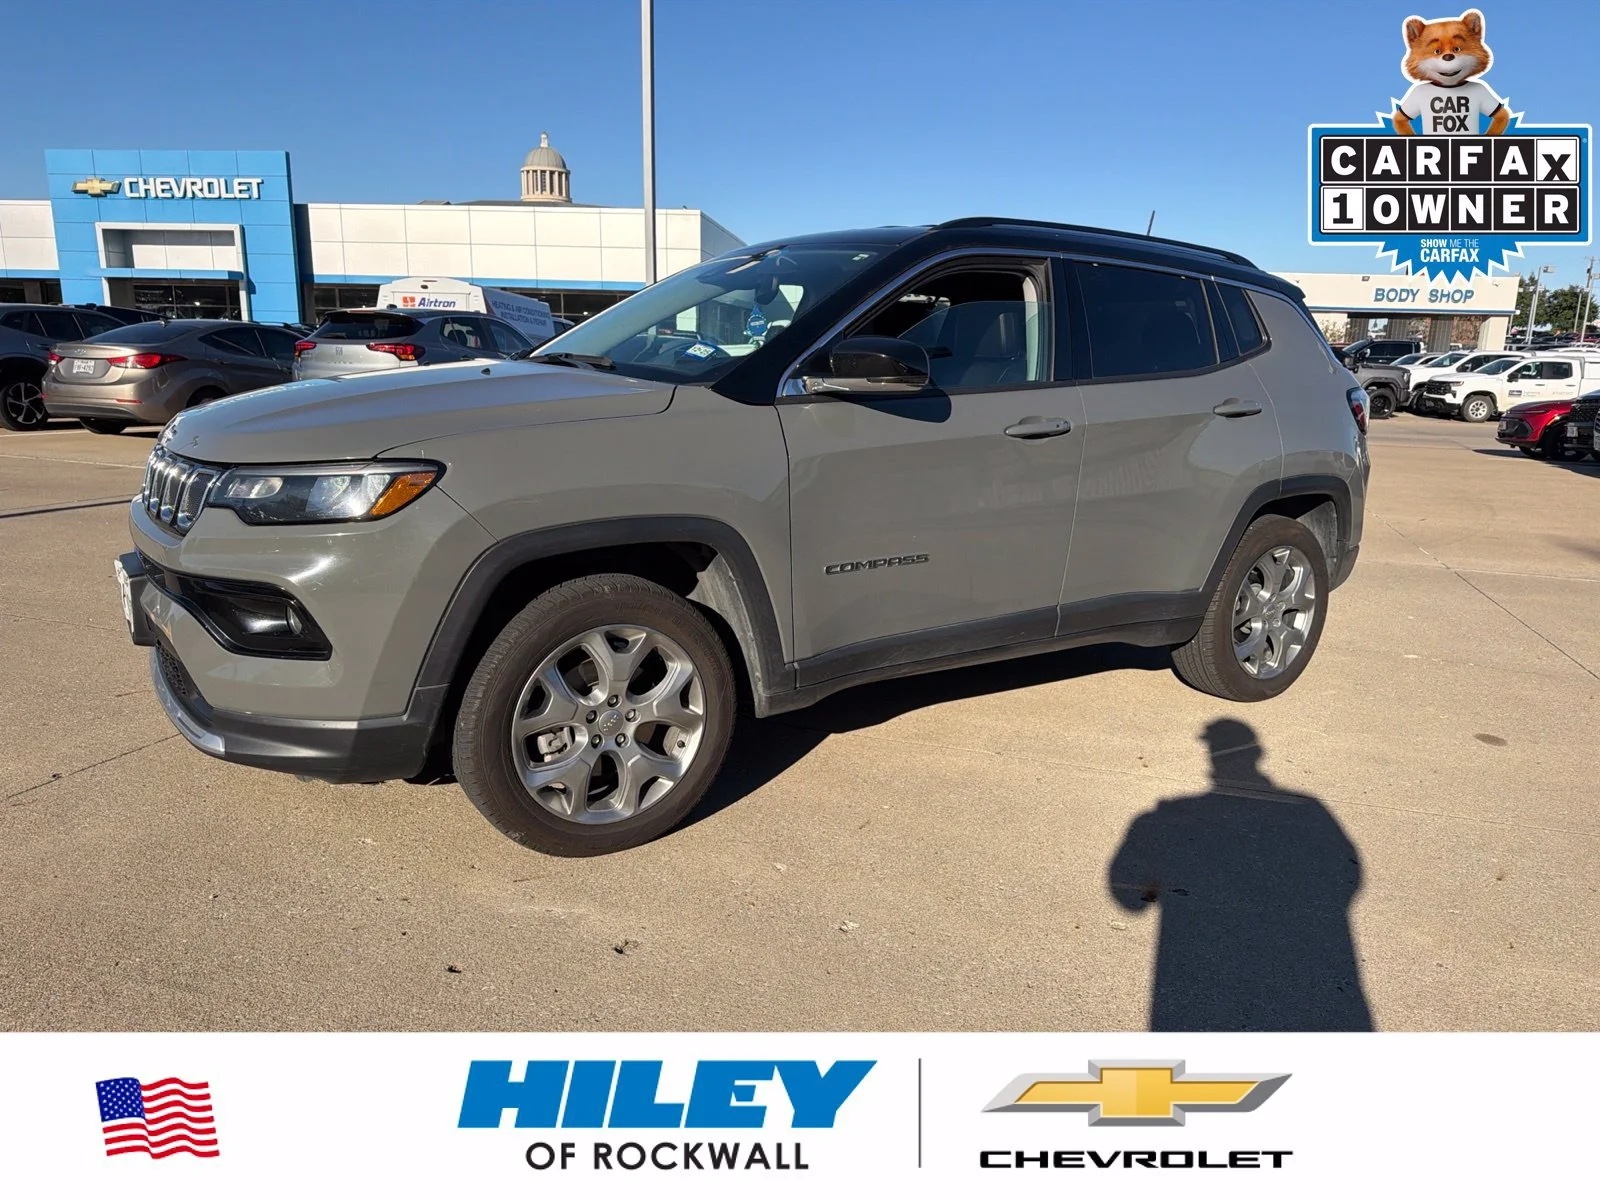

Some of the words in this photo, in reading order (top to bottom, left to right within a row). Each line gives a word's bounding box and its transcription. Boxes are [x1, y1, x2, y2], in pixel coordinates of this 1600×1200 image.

[123, 177, 263, 199] CHEVROLET
[417, 297, 457, 308] Airtron
[1373, 287, 1420, 303] BODY
[1428, 288, 1475, 304] SHOP
[824, 553, 930, 576] COMPASS
